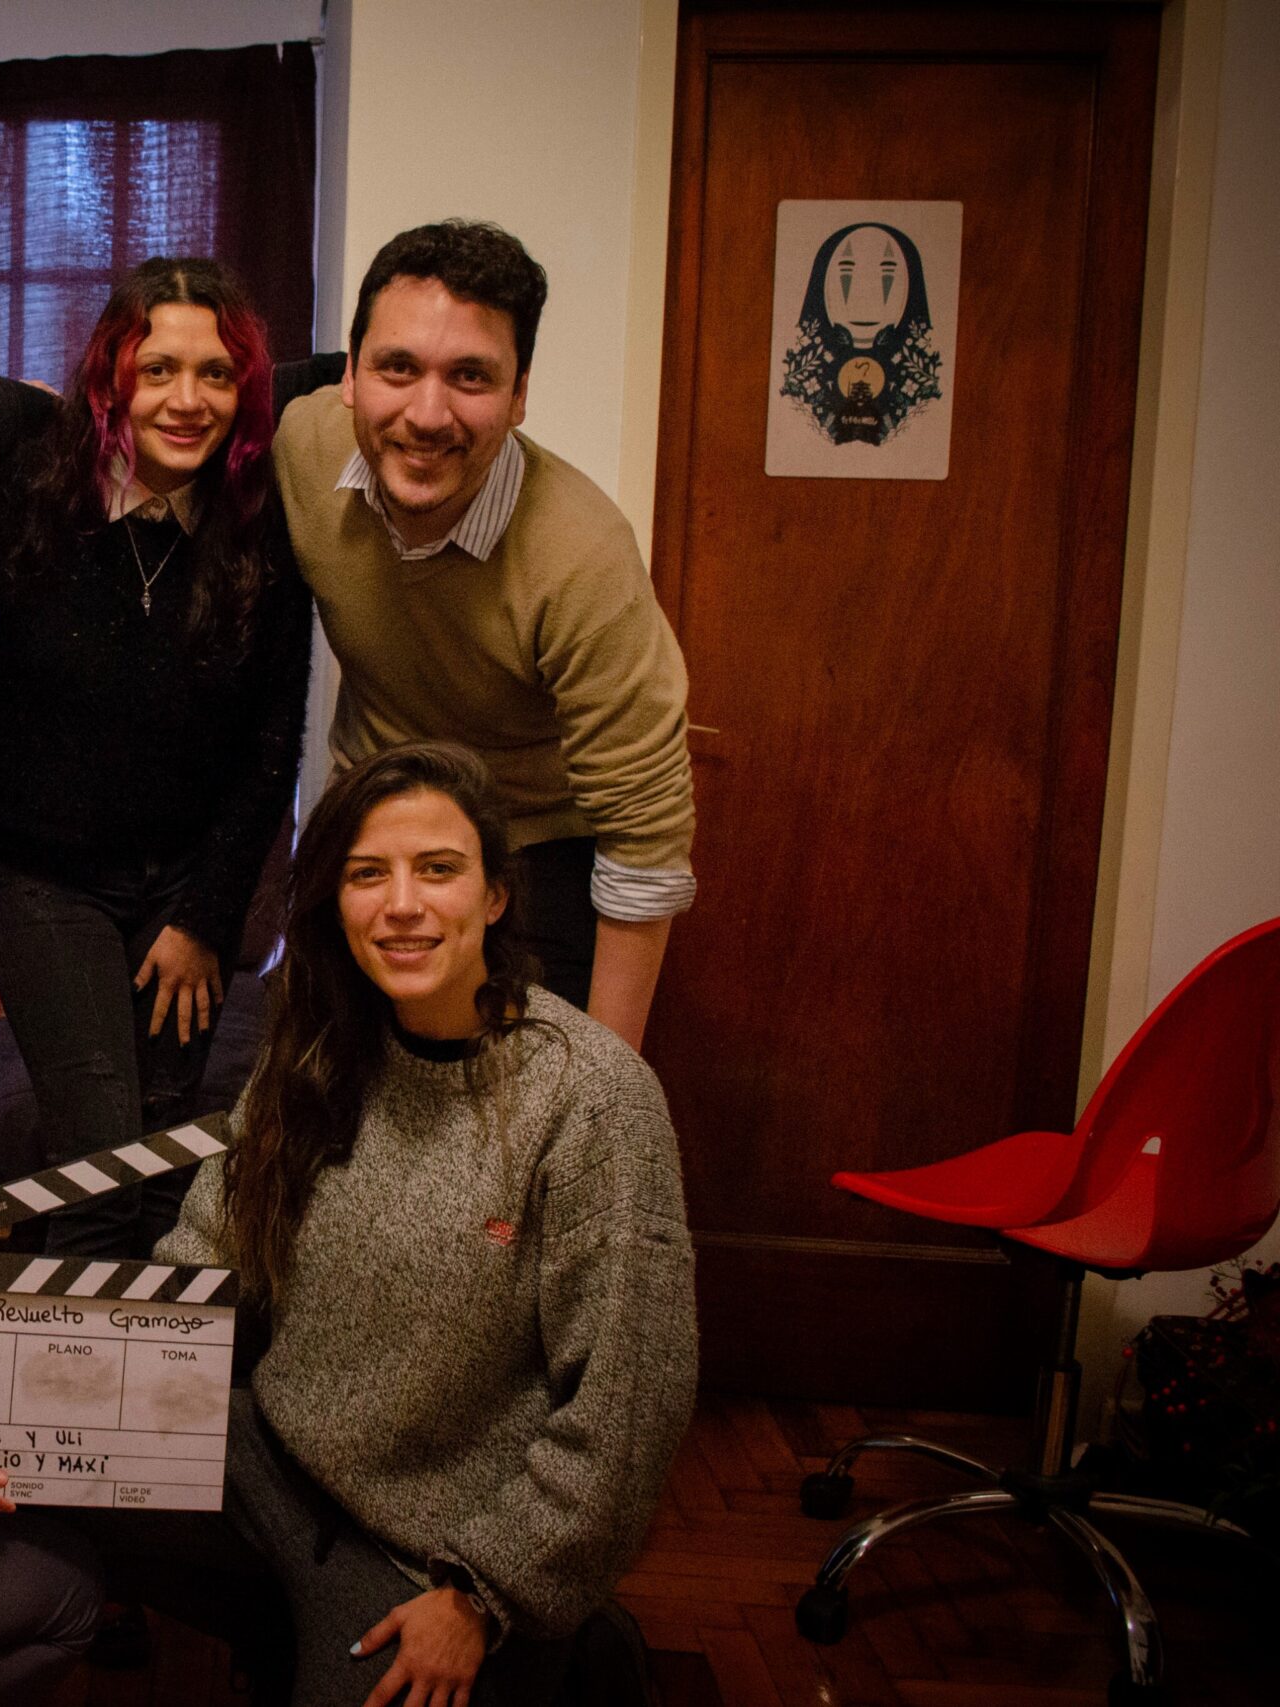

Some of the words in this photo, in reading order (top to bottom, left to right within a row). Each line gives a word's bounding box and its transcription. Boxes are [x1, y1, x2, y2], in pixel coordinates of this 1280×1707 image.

[48, 1344, 93, 1356] PLANO
[161, 1350, 198, 1361] TOMA
[10, 1482, 44, 1490] SONIDO
[10, 1490, 33, 1498] SYNC
[120, 1487, 138, 1495] CLIP
